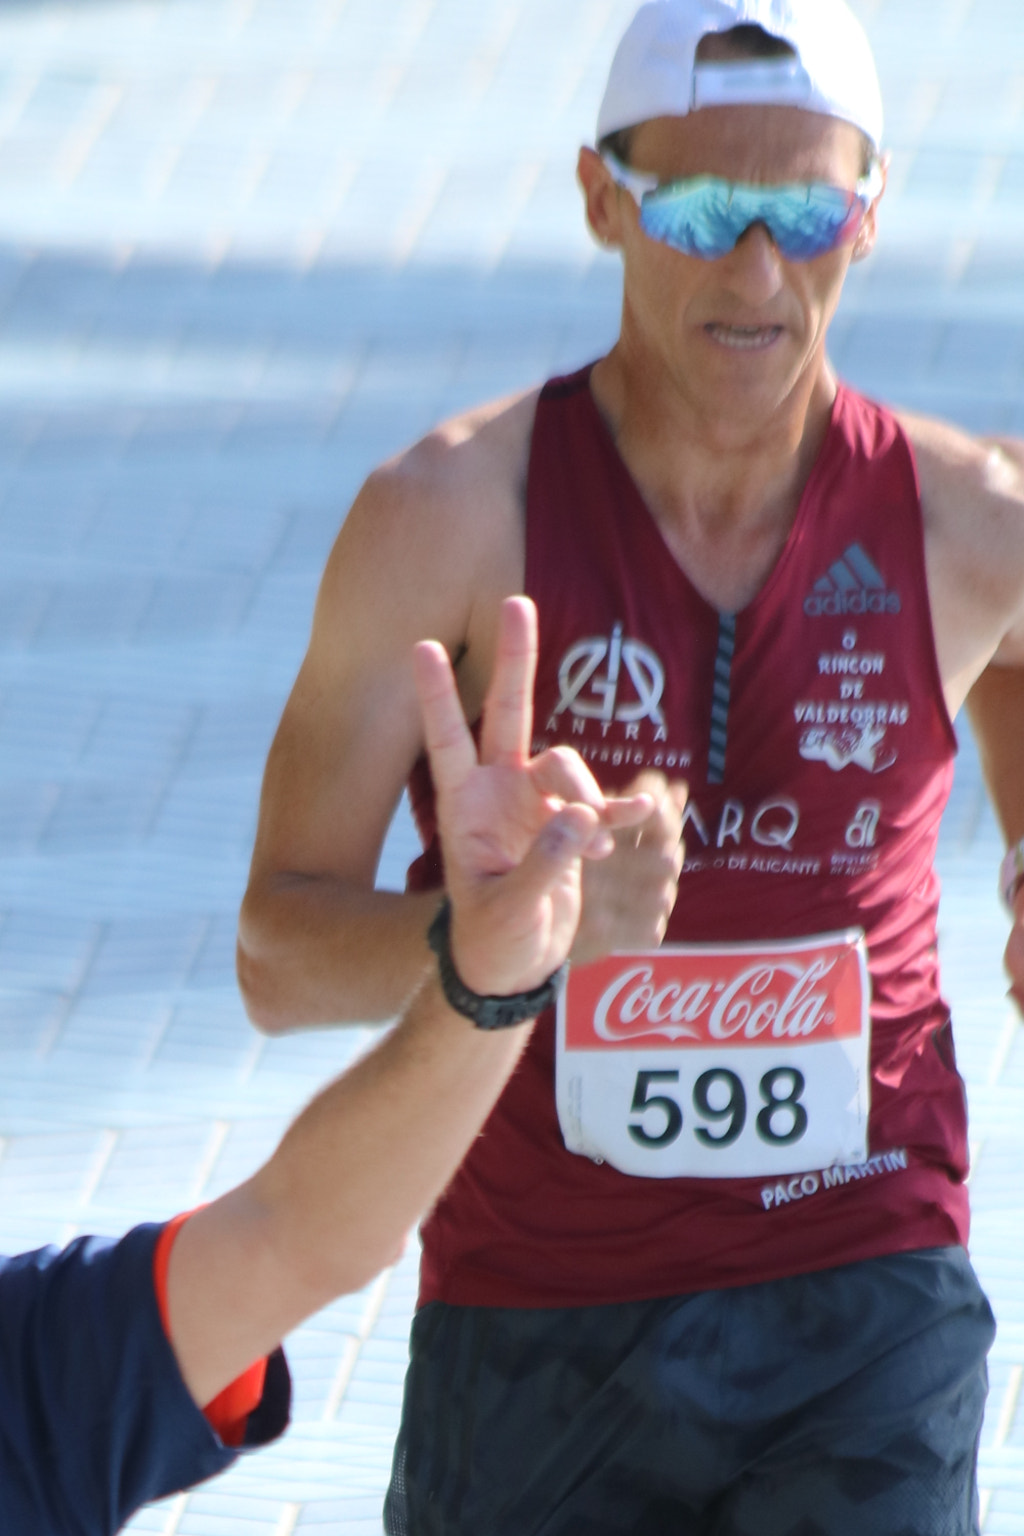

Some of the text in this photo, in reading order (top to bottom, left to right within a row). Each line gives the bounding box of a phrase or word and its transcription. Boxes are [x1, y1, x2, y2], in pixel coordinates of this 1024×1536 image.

[803, 588, 902, 616] adidas
[841, 630, 857, 650] O
[818, 653, 885, 674] RINCON
[840, 678, 864, 699] DE
[794, 703, 908, 726] VALDEORRAS
[545, 716, 667, 743] ANTRA
[749, 858, 820, 875] ALICANTE
[593, 957, 836, 1042] Coca-Cola
[627, 1066, 808, 1151] 598
[760, 1175, 819, 1210] PACO
